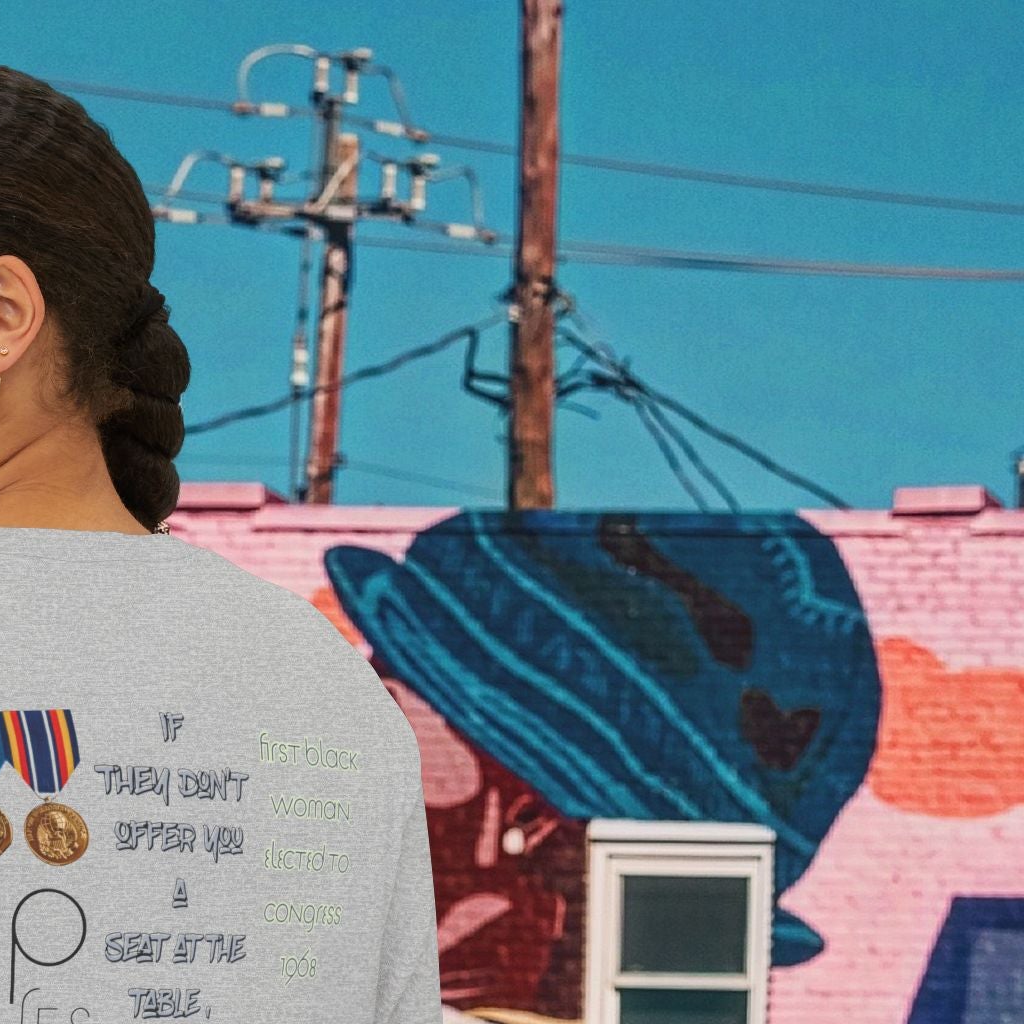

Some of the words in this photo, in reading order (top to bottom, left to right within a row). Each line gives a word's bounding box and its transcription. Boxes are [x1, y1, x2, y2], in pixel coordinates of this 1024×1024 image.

[158, 711, 184, 742] IF
[94, 765, 171, 806] THEY
[177, 766, 249, 801] DON'T
[114, 820, 197, 852] OFFER
[202, 824, 244, 863] YOU
[172, 878, 188, 908] A
[105, 932, 171, 963] SEAT
[173, 933, 205, 963] AT
[206, 933, 247, 963] THE
[280, 949, 317, 985] 1968
